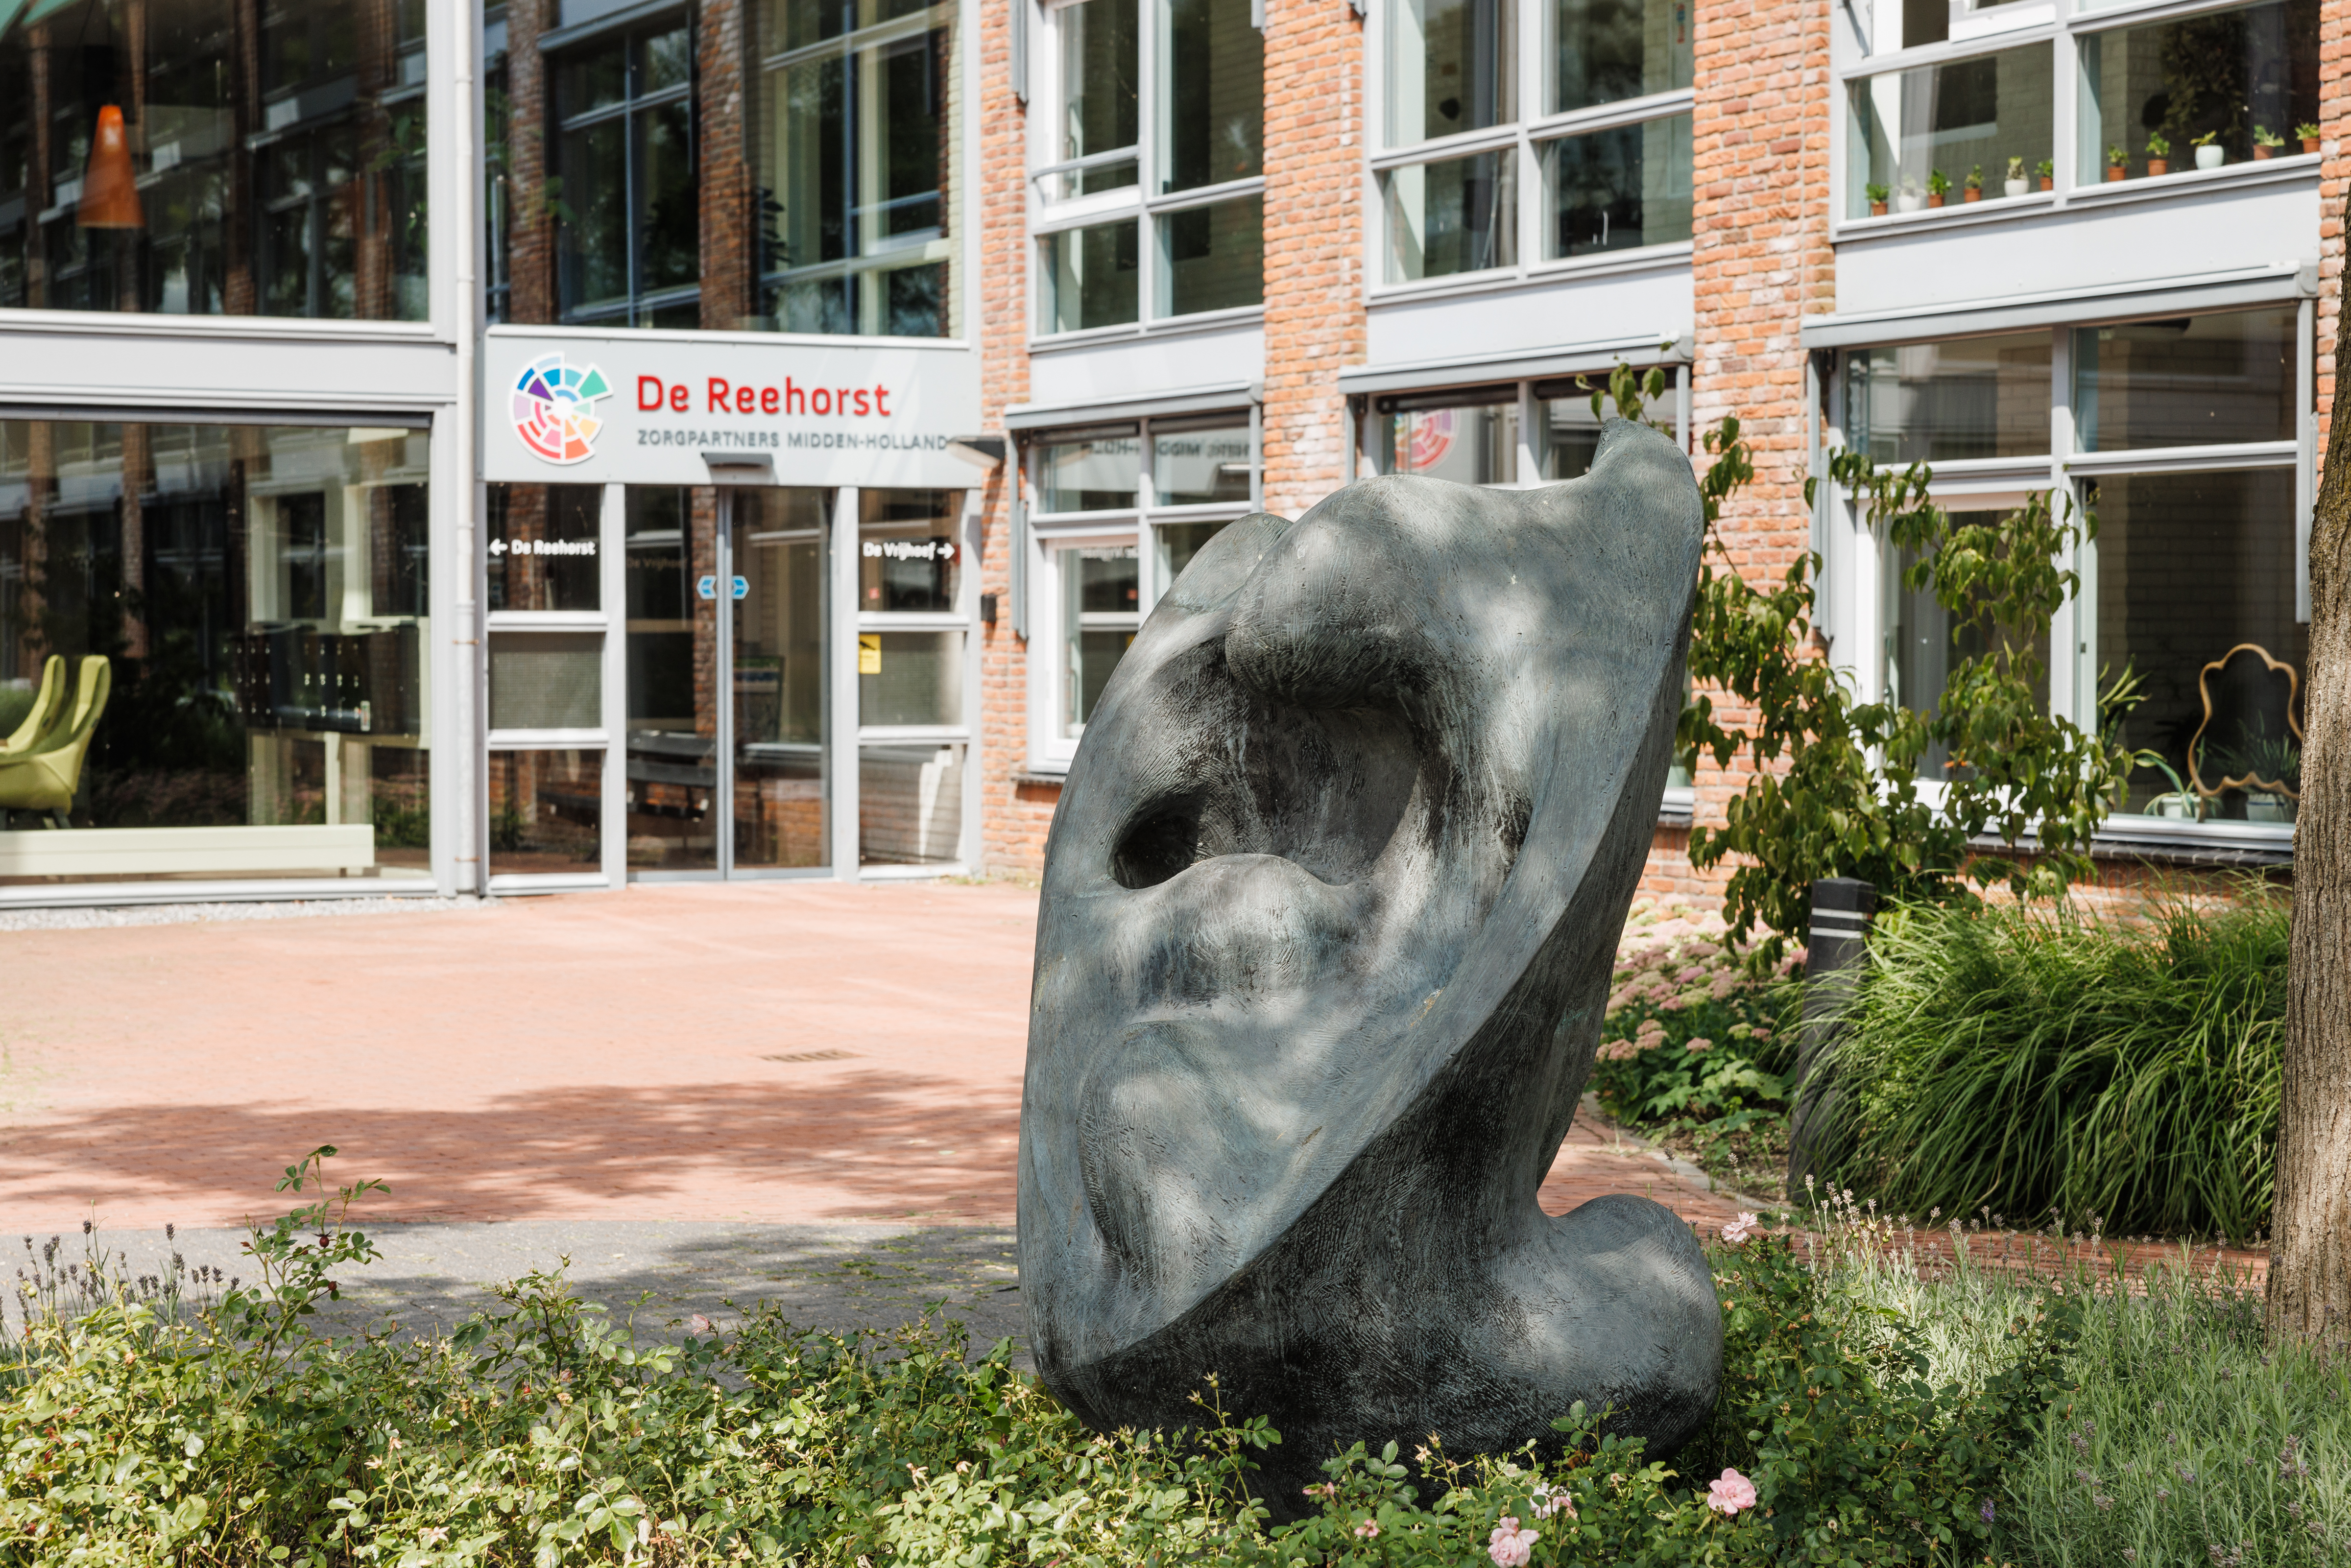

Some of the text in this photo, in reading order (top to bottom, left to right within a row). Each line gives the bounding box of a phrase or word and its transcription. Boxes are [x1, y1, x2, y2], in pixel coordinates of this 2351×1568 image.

[638, 376, 890, 416] De Reehorst
[638, 429, 947, 450] ZORGPARTNERS MIDDEN-HOLLAND
[511, 539, 596, 555] De Reehorst
[863, 542, 882, 557] De
